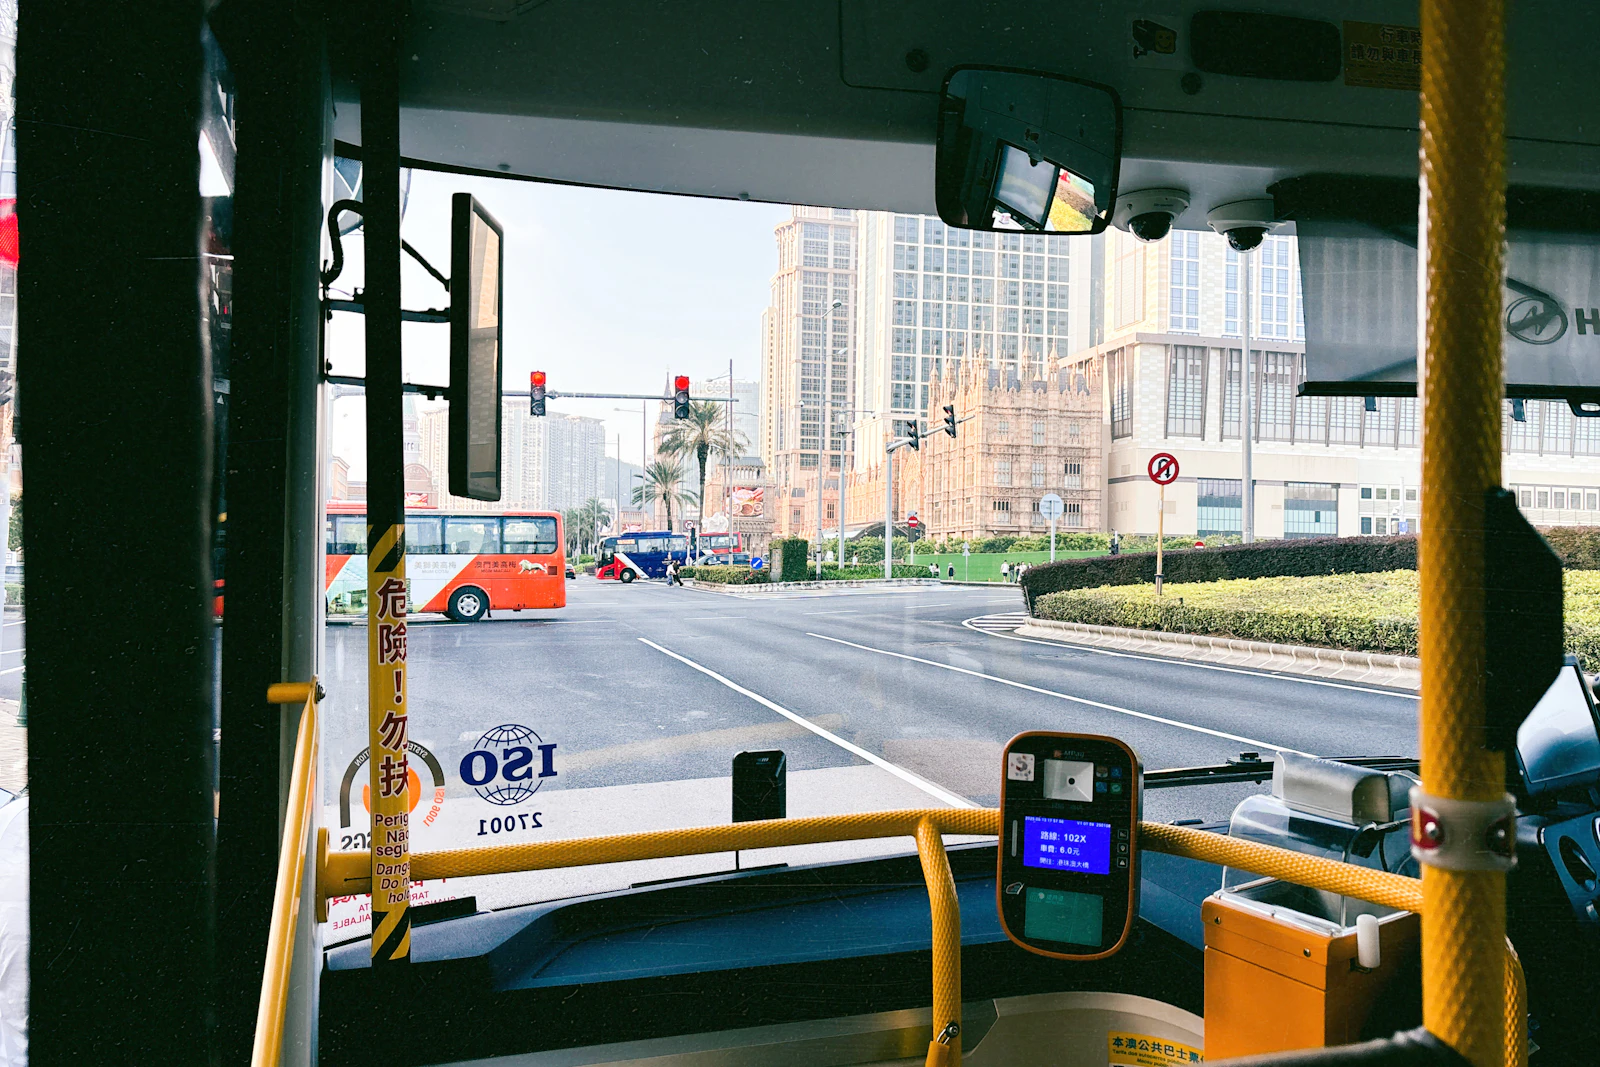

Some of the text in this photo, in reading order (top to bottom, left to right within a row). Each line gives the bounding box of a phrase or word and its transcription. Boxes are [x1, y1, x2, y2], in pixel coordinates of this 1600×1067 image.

[1064, 833, 1086, 843] 102X
[1060, 846, 1080, 856] 6.0元
[376, 862, 410, 875] Dang
[381, 878, 399, 889] Do
